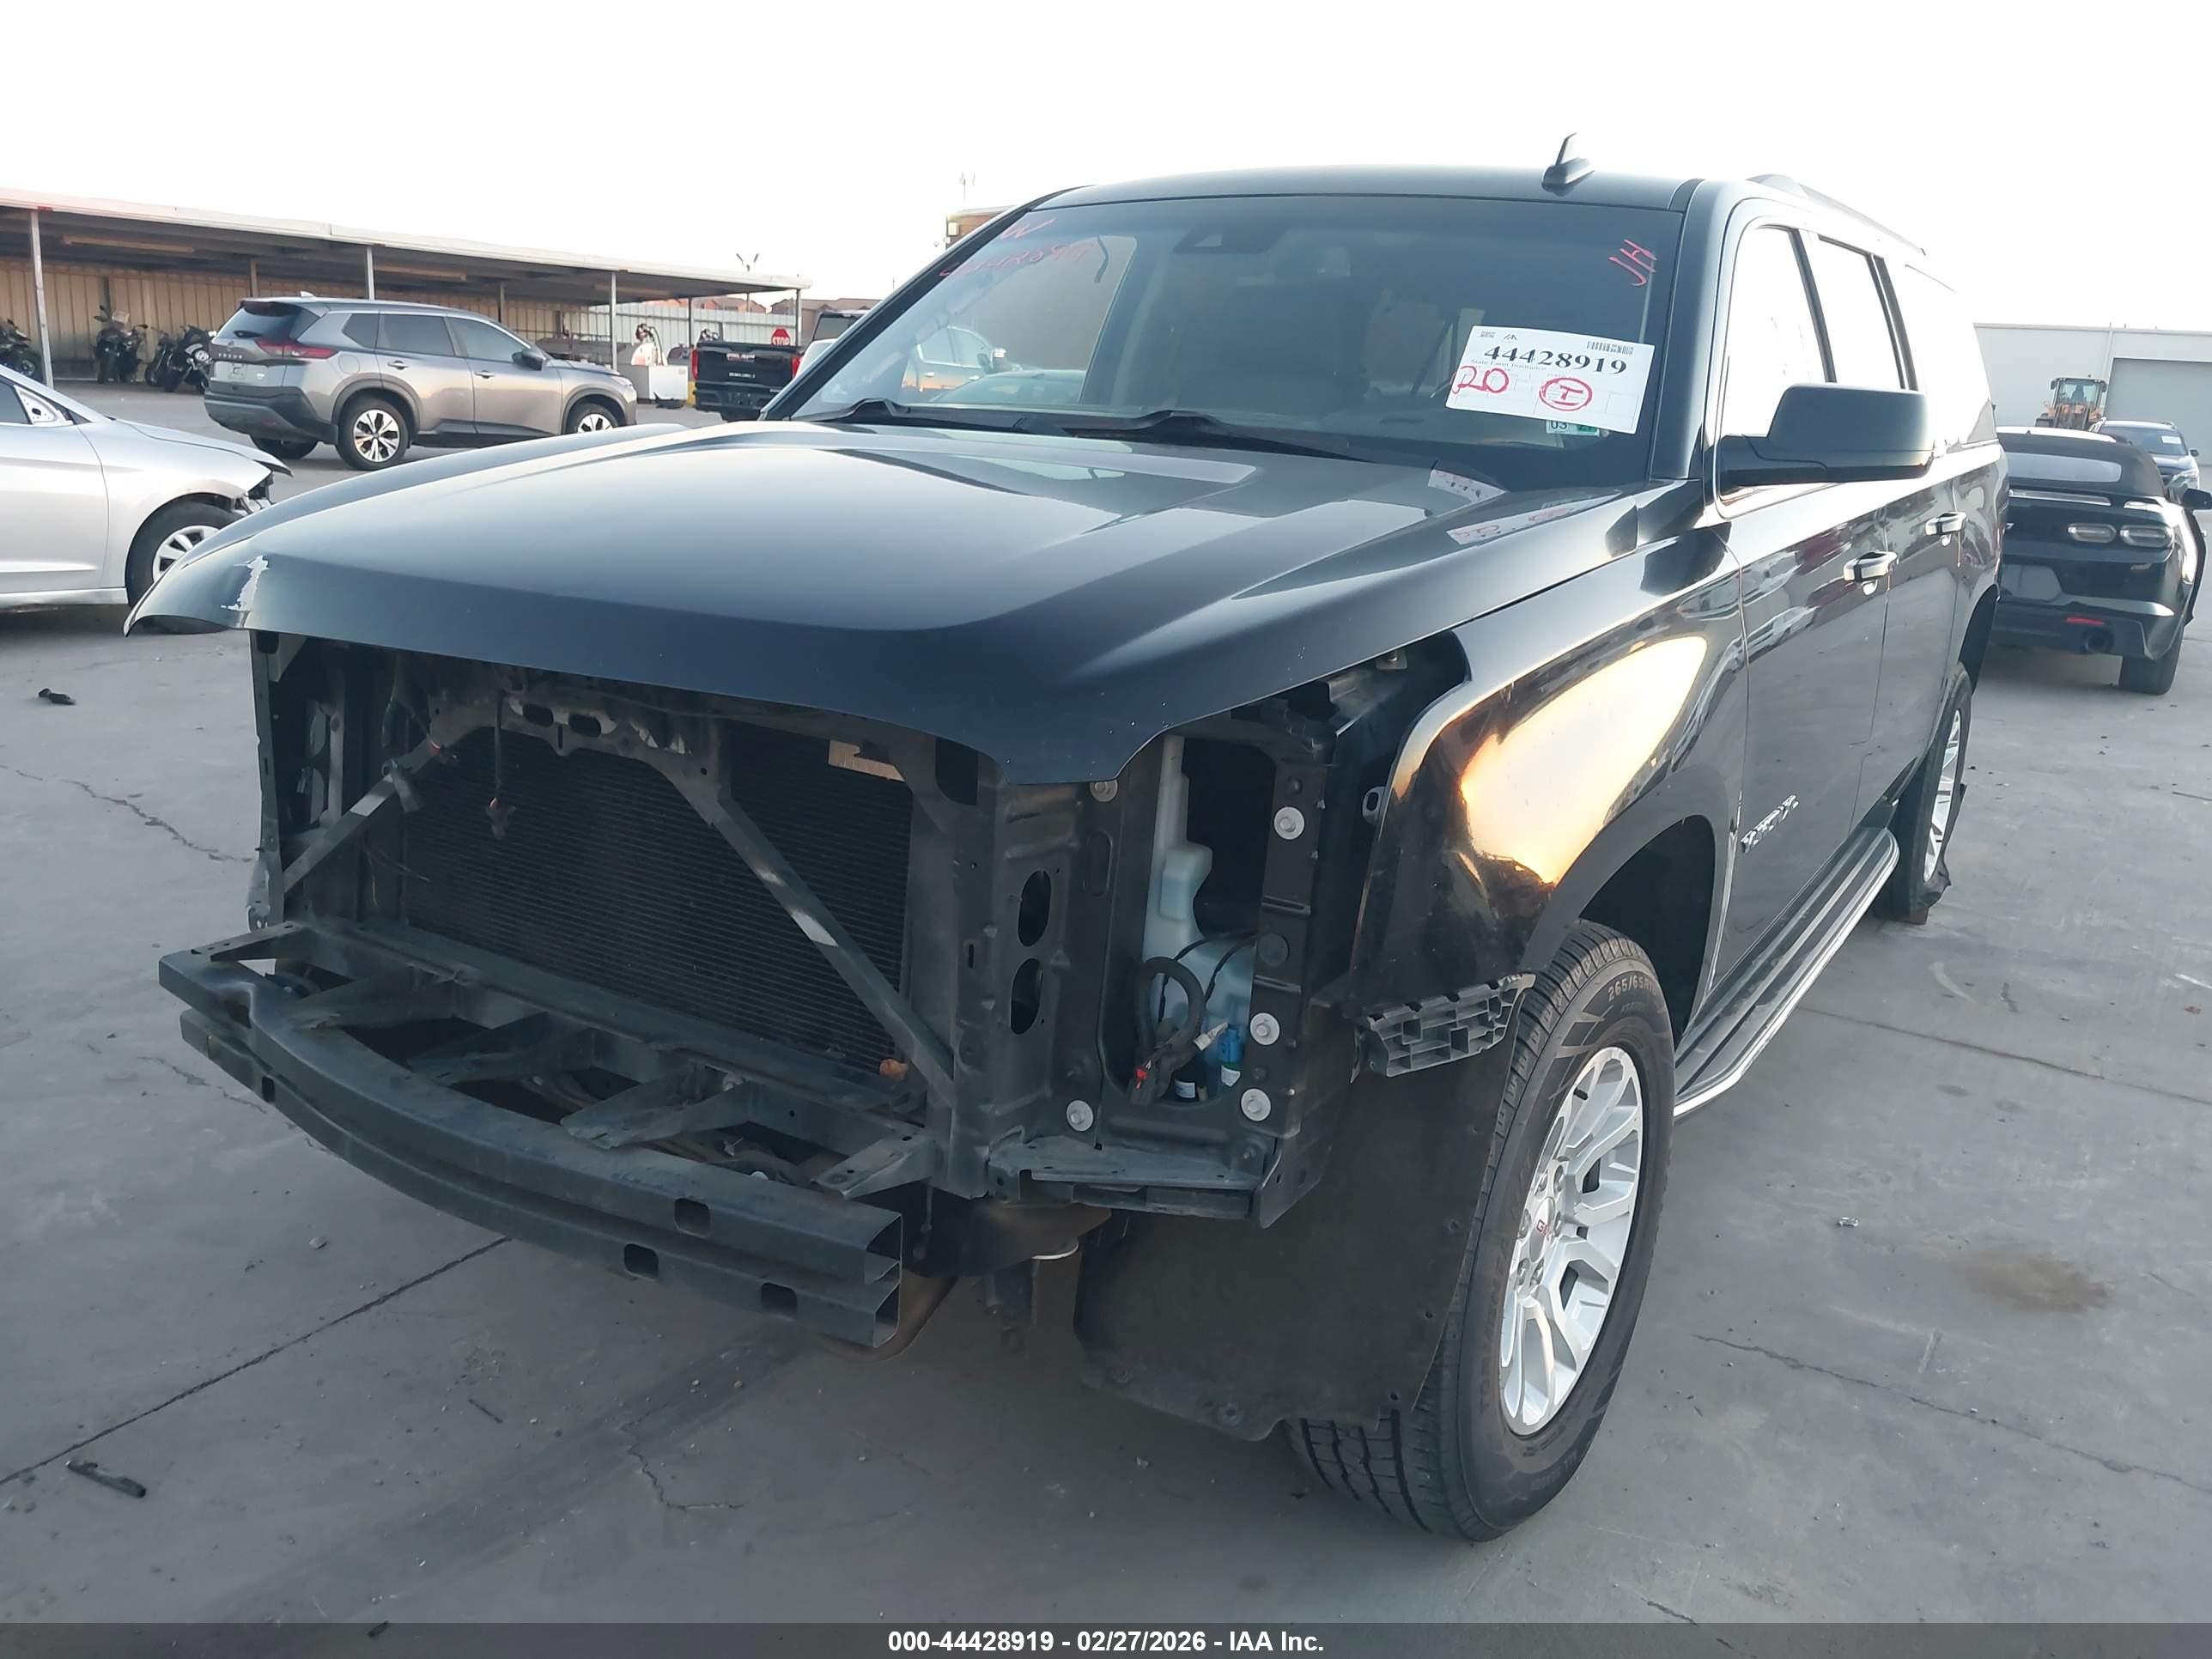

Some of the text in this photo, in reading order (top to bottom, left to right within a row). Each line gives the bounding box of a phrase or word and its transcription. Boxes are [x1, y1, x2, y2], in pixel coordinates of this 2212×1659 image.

[772, 336, 790, 346] STOP
[1484, 345, 1627, 375] 44428919
[1451, 365, 1510, 395] 20
